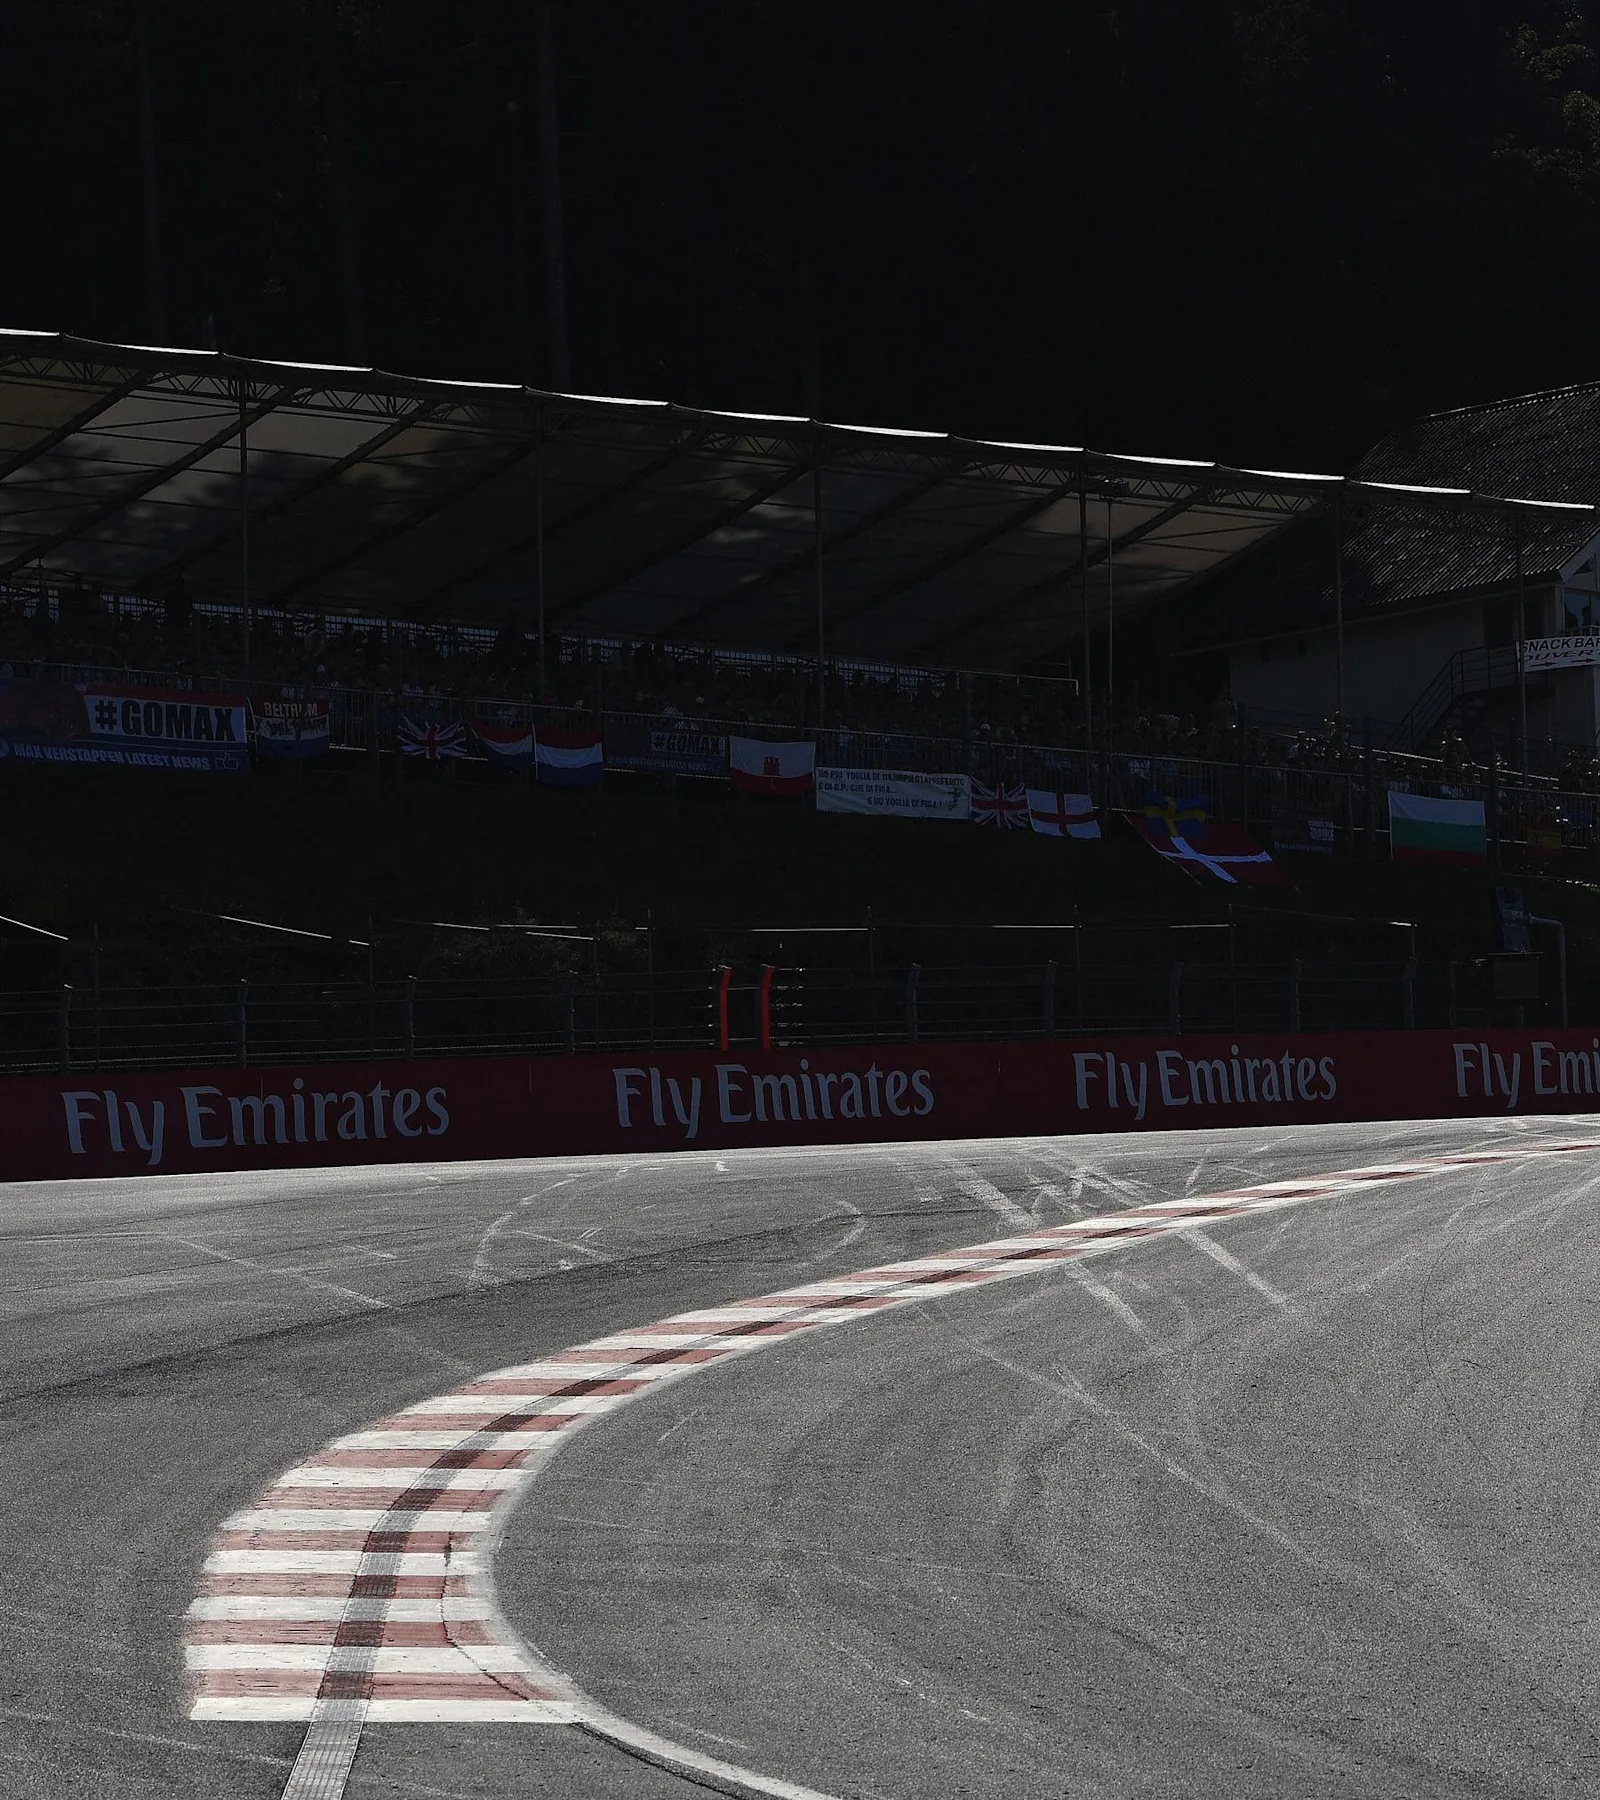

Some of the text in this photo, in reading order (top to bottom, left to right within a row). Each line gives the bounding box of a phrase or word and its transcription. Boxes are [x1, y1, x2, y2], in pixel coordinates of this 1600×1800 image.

[1523, 639, 1572, 653] SNACK
[95, 699, 236, 741] #GOMAX
[14, 743, 211, 770] MAX VERSTAPPEN LATEST NEWS
[612, 1059, 933, 1138] Fly Emirates
[1073, 1045, 1336, 1120] Fly Emirates
[1453, 1043, 1520, 1108] Fly
[61, 1078, 449, 1165] Fly Emirates
